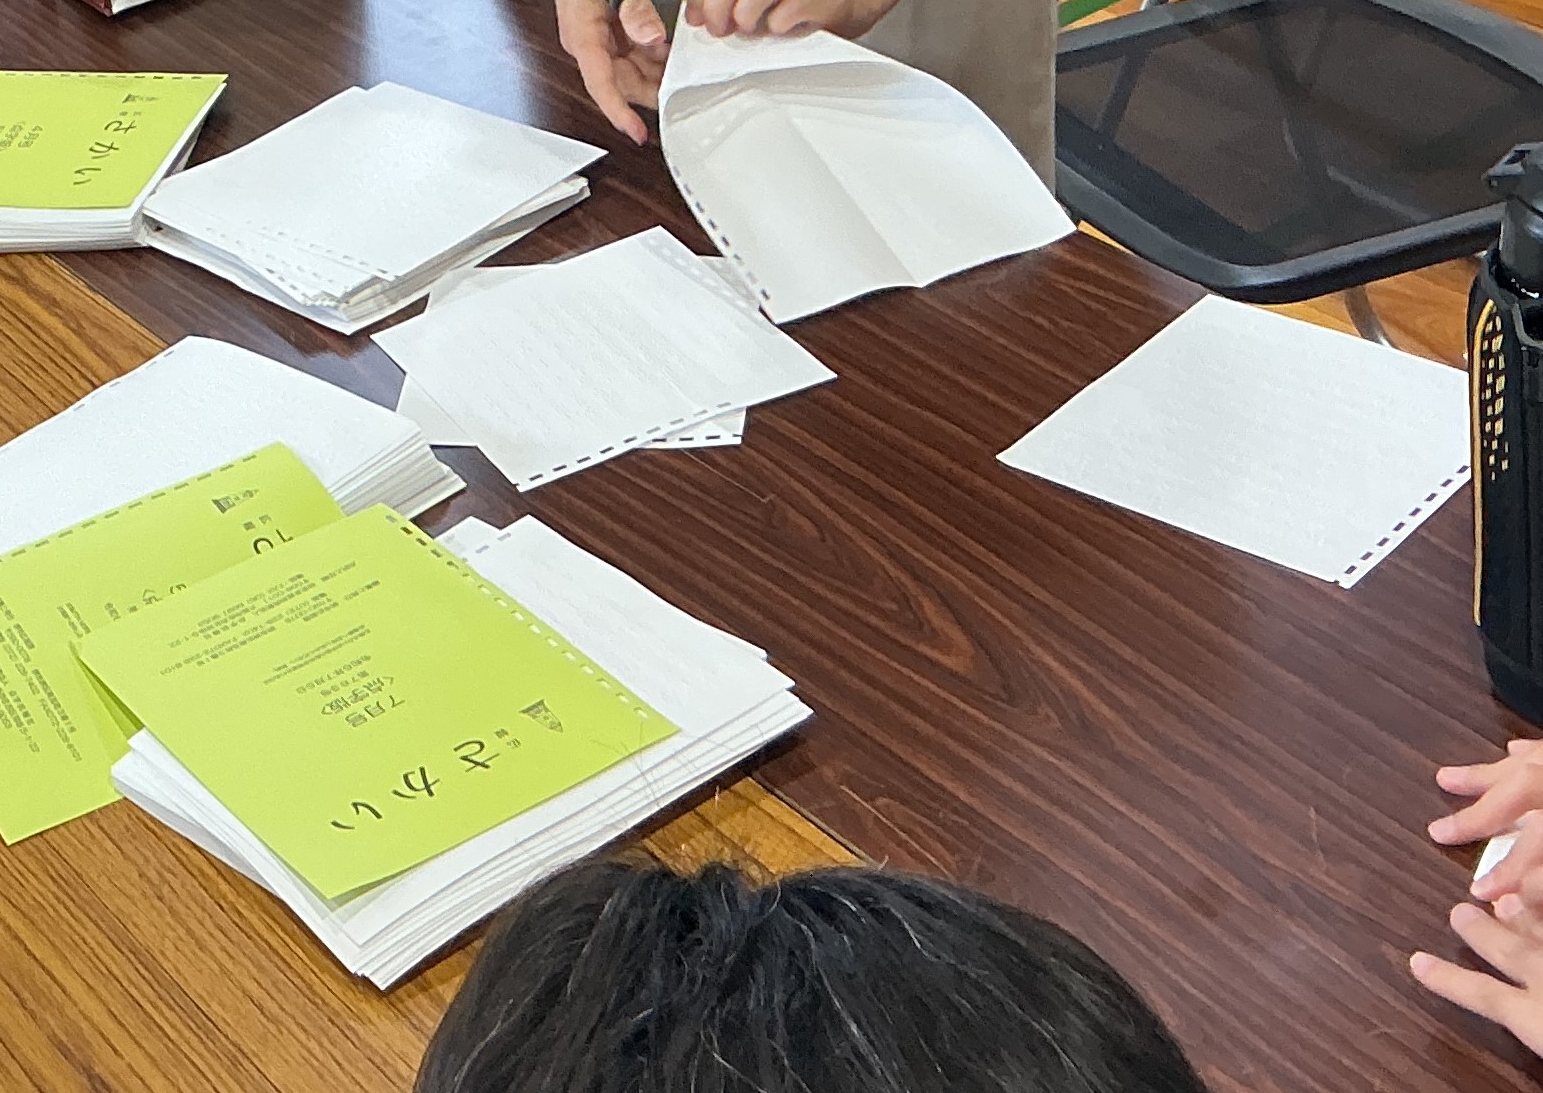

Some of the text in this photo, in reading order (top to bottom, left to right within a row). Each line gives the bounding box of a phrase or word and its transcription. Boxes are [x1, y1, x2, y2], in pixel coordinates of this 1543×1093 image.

[73, 120, 137, 186] さかい
[345, 695, 405, 727] 7月号
[330, 740, 501, 830] さかい
